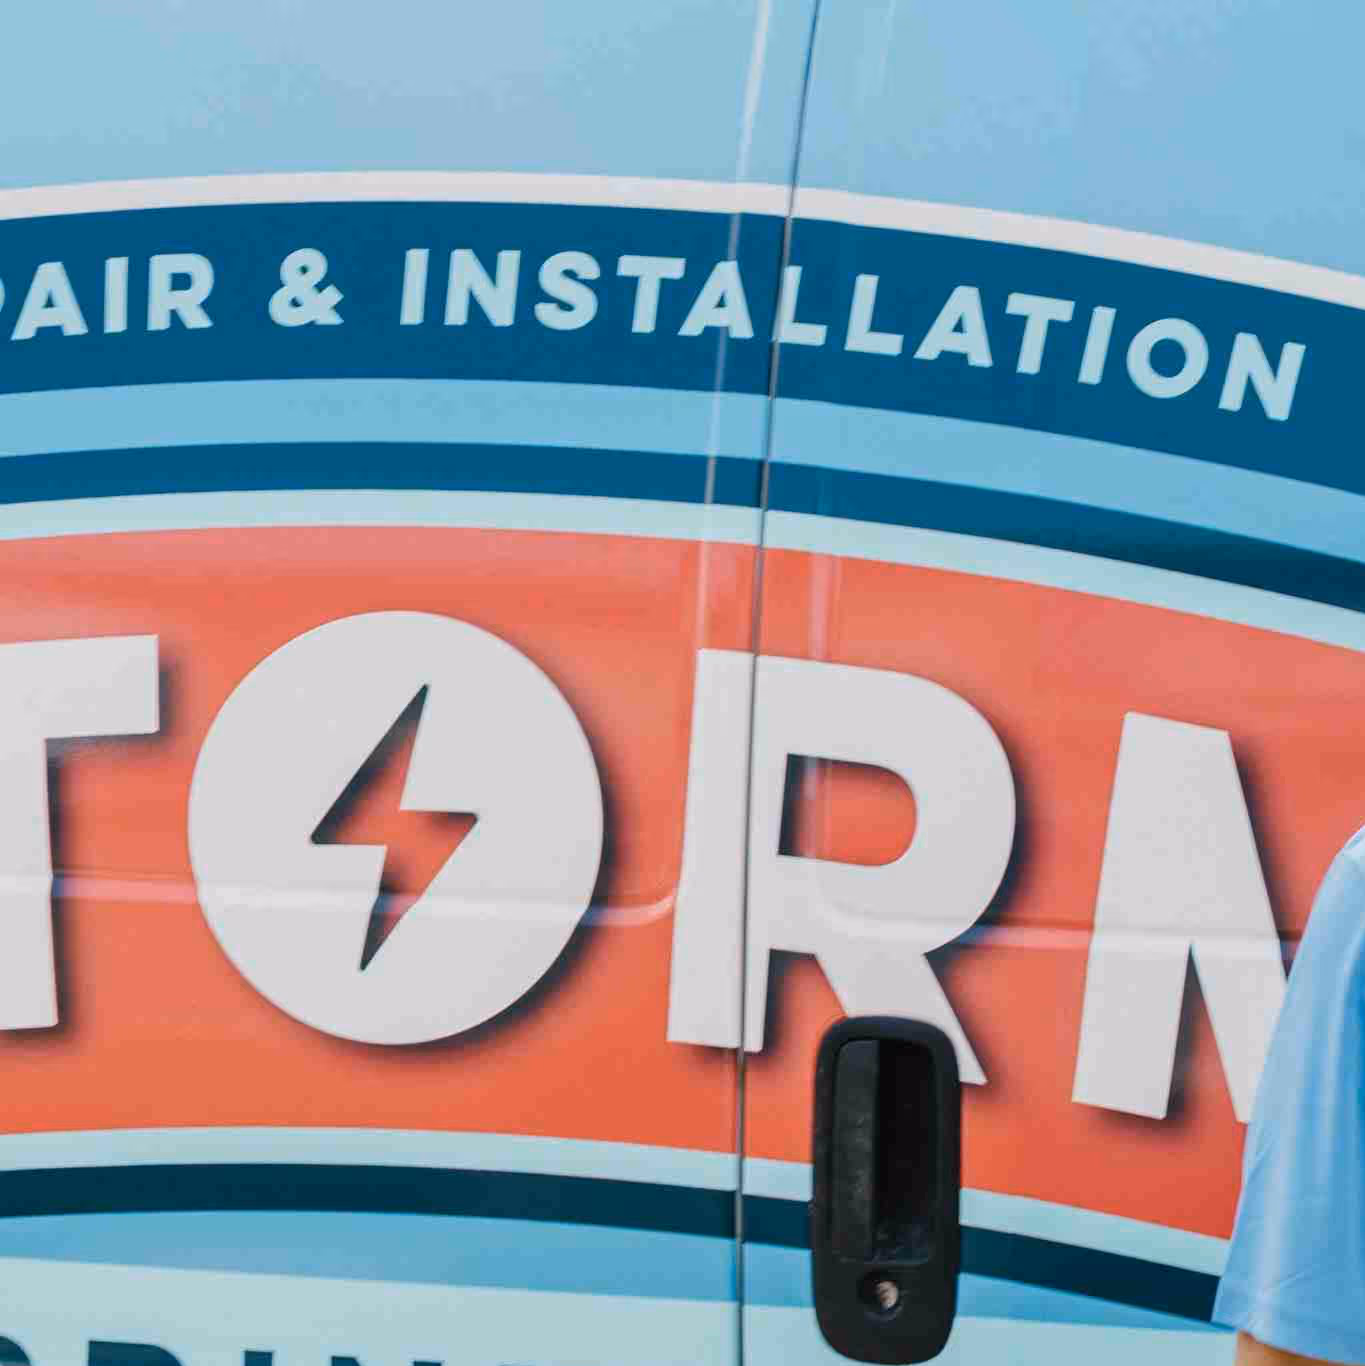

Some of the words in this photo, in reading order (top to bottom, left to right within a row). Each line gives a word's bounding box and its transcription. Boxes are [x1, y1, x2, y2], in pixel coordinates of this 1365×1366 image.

[0, 253, 214, 341] AIR
[267, 246, 345, 327] &
[400, 247, 1307, 422] INSTALLATION
